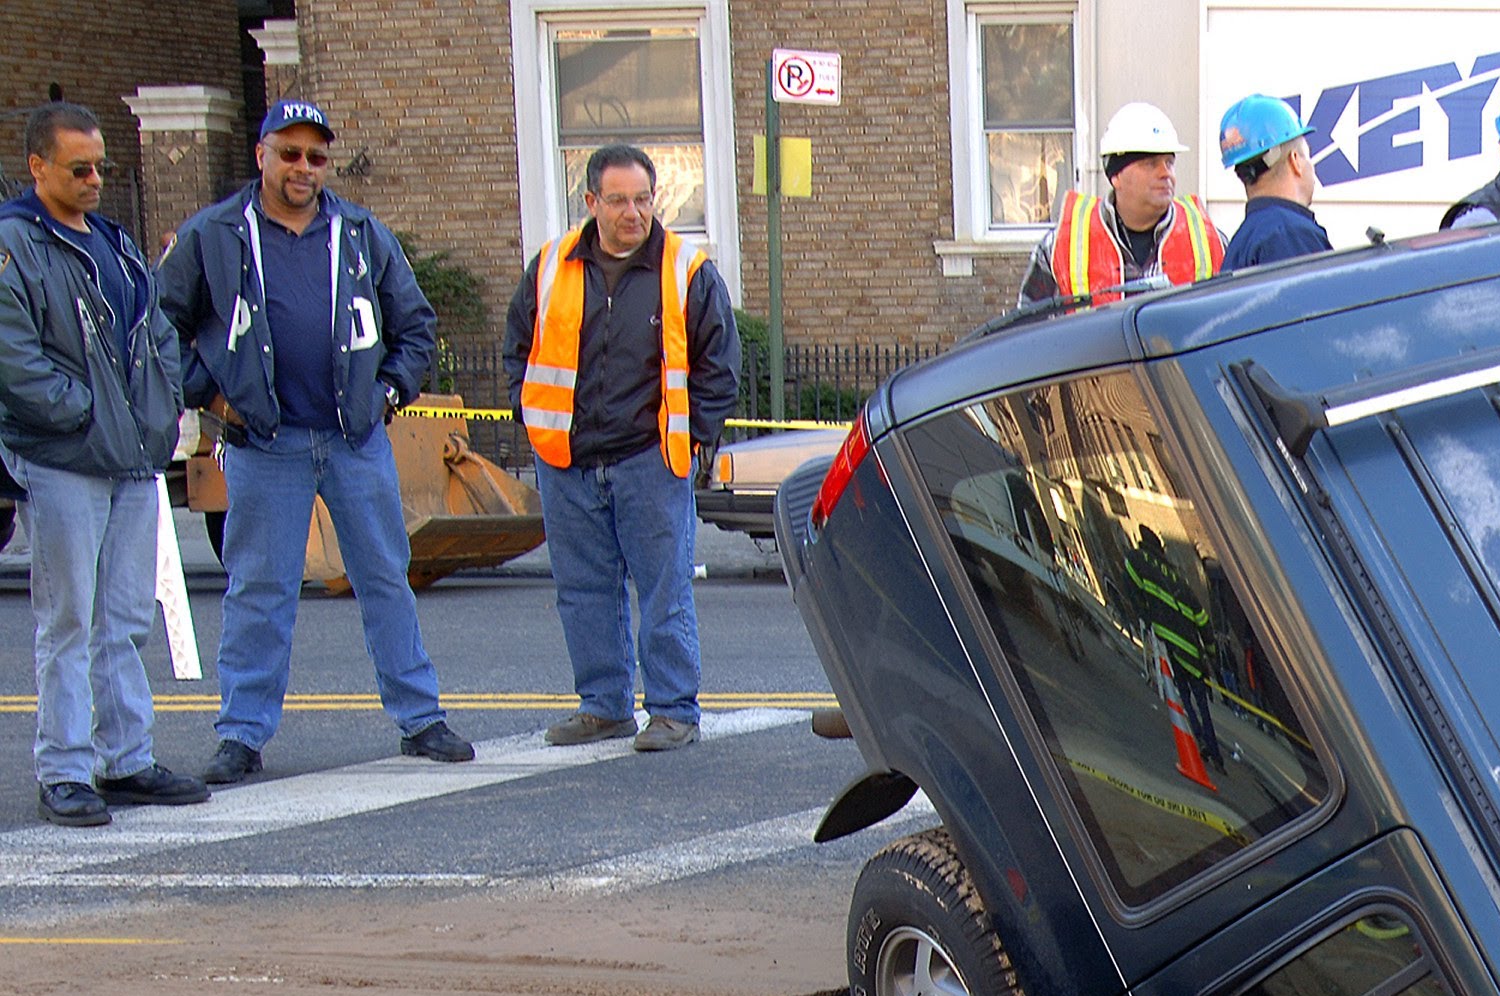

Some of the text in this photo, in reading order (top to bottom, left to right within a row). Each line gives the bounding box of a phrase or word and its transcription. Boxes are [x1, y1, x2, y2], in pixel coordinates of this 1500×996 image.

[283, 103, 323, 124] NYPD
[227, 294, 379, 352] P D
